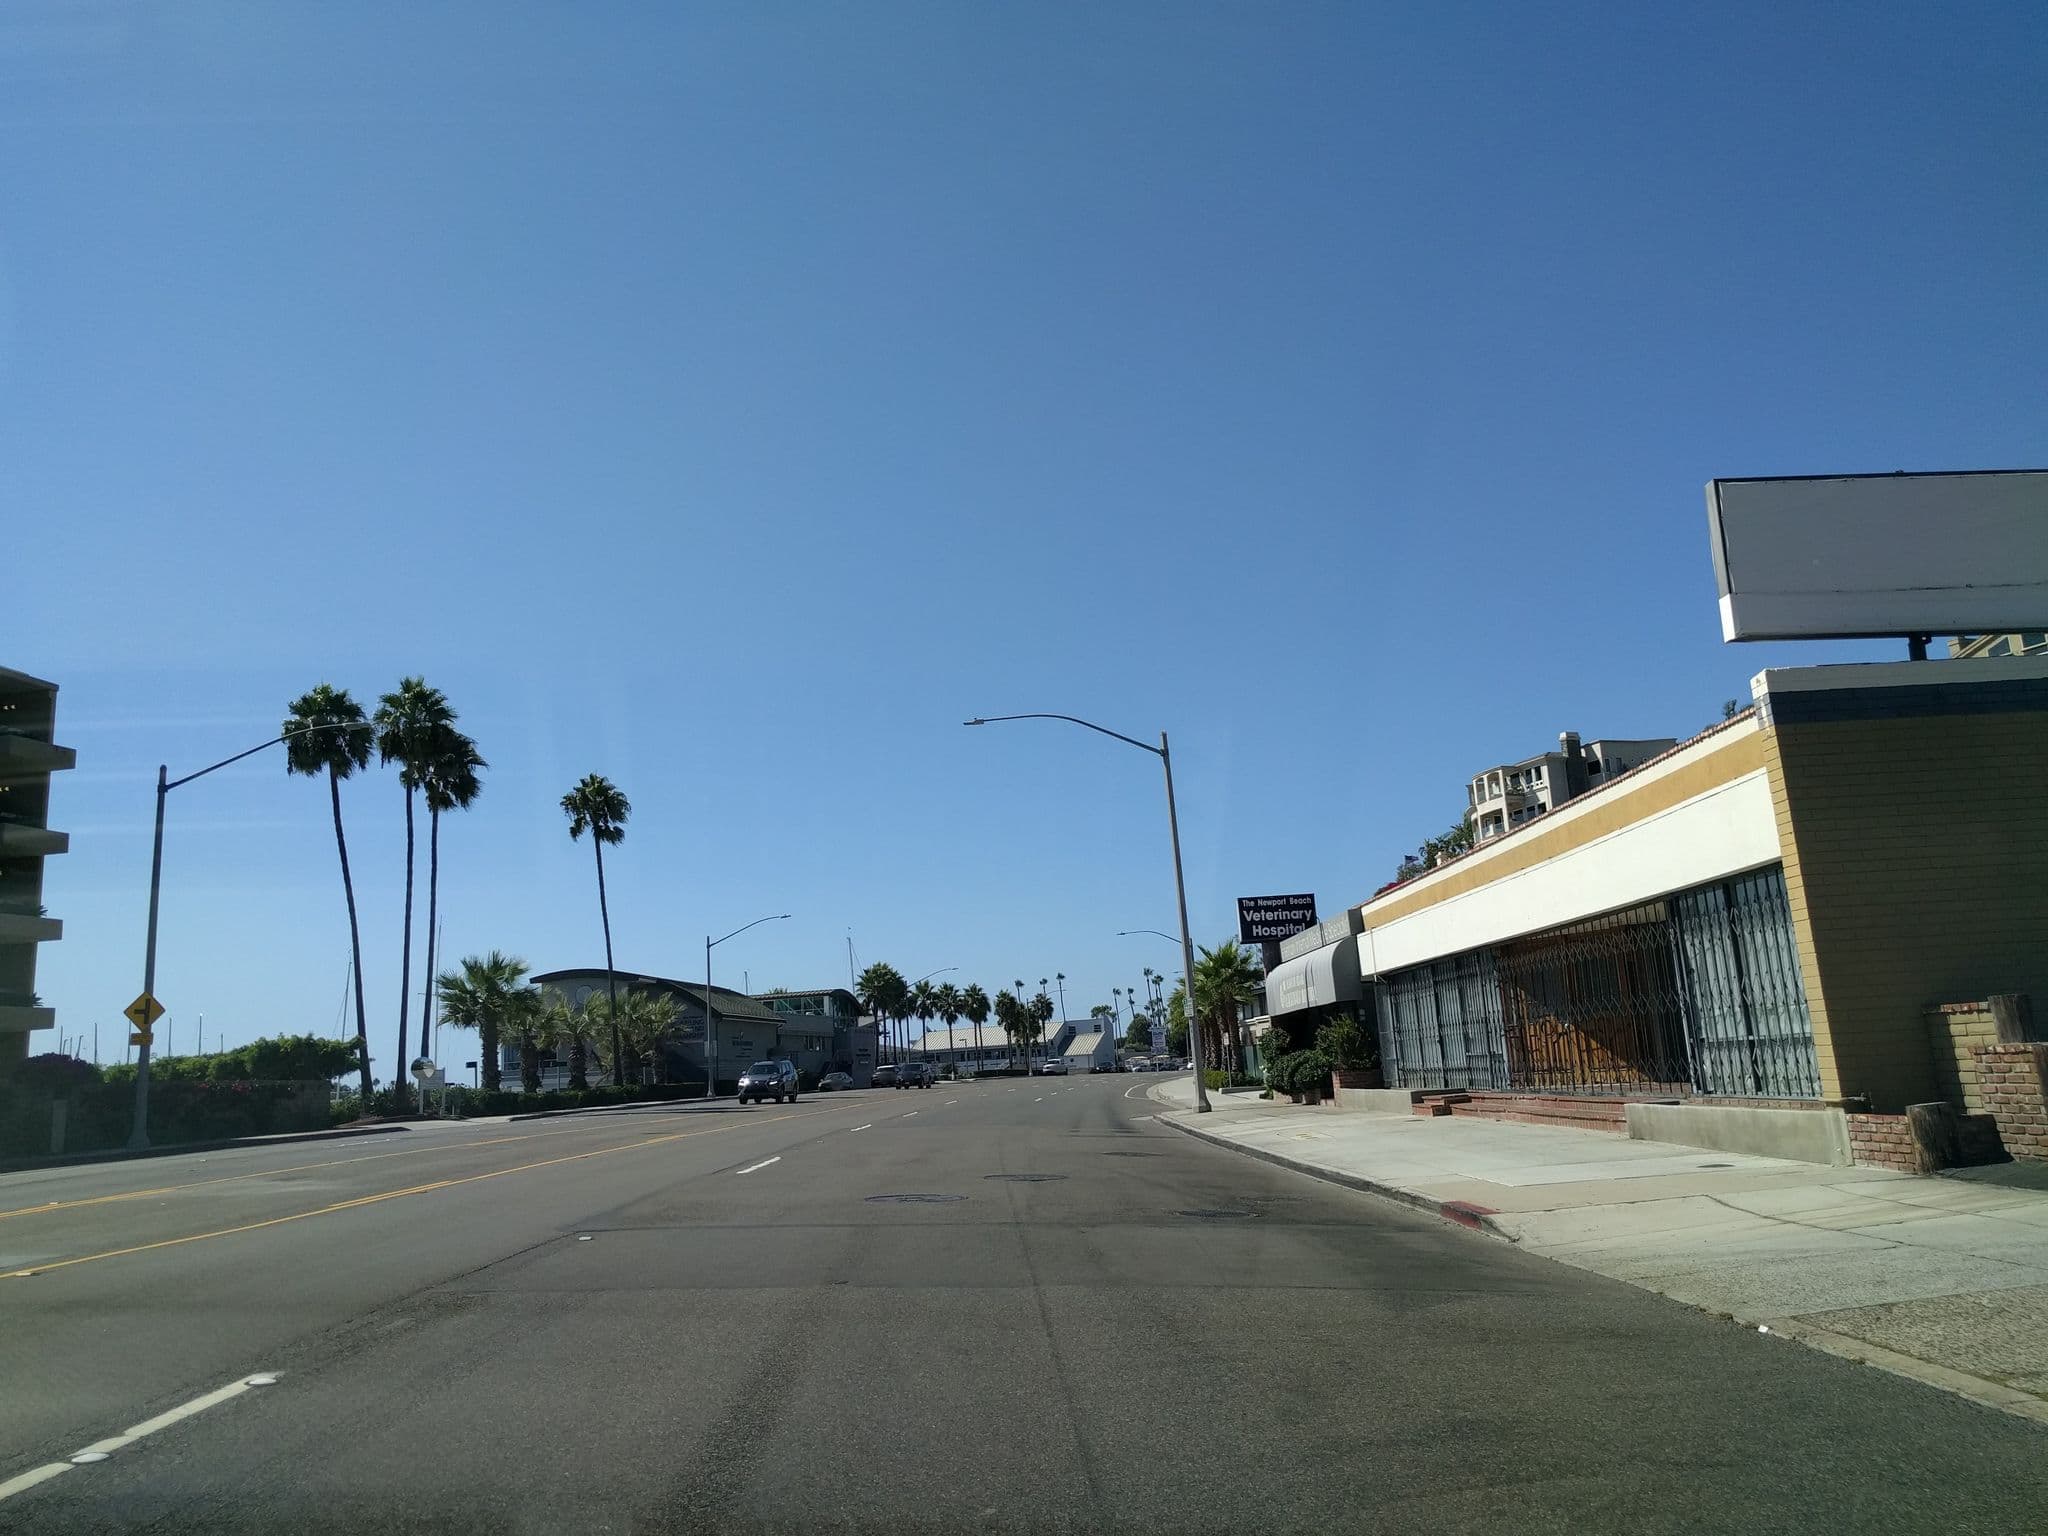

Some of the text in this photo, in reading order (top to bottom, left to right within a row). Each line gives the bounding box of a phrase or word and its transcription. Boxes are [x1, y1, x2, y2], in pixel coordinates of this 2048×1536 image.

[1242, 896, 1312, 907] The Newport Beach
[1243, 909, 1313, 922] Veterinary
[1252, 922, 1306, 937] Hospital
